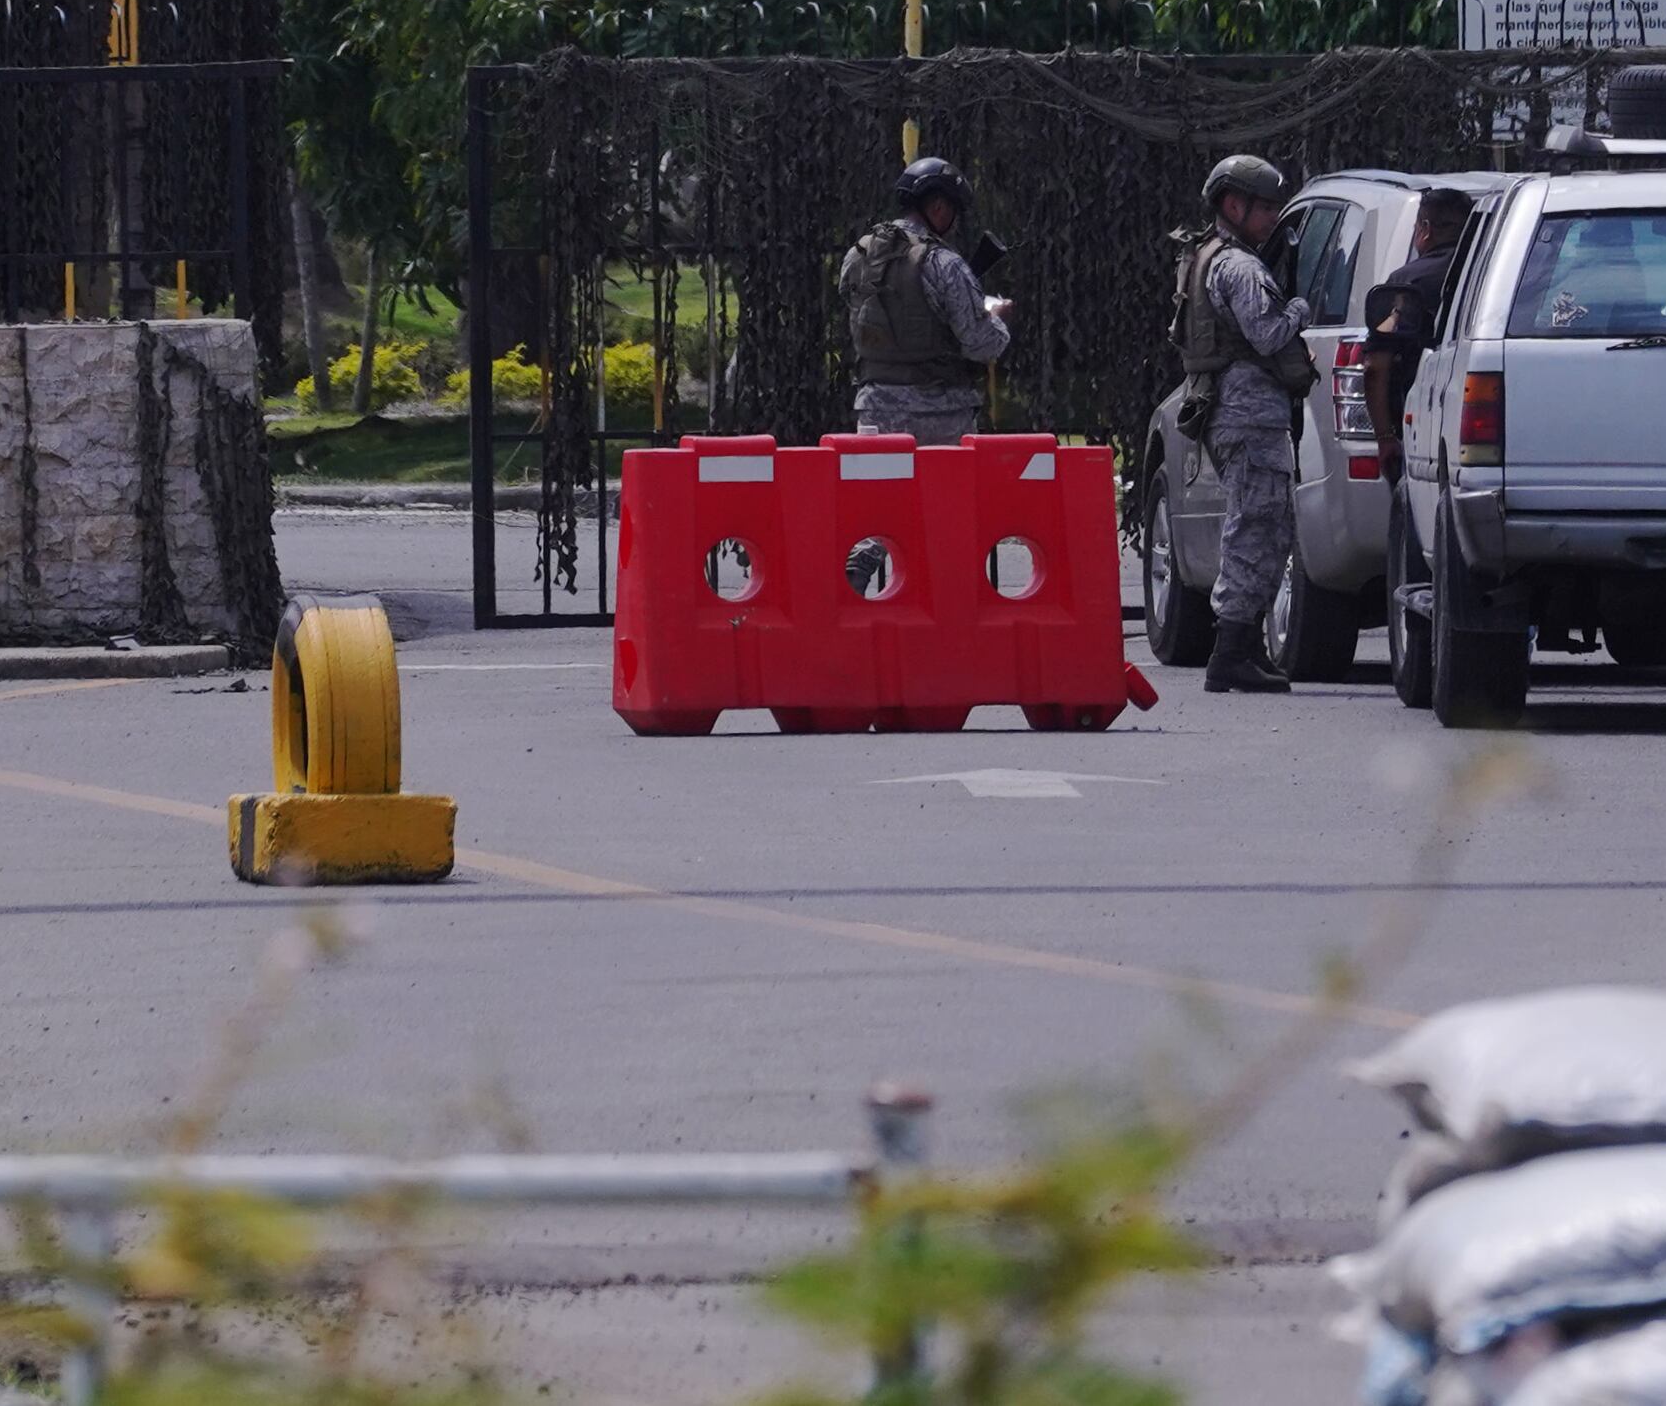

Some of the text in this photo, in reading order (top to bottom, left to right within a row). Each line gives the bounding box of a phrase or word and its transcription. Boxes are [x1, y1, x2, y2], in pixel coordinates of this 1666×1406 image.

[1495, 3, 1503, 13] a
[1511, 0, 1531, 12] las
[1573, 0, 1614, 12] used
